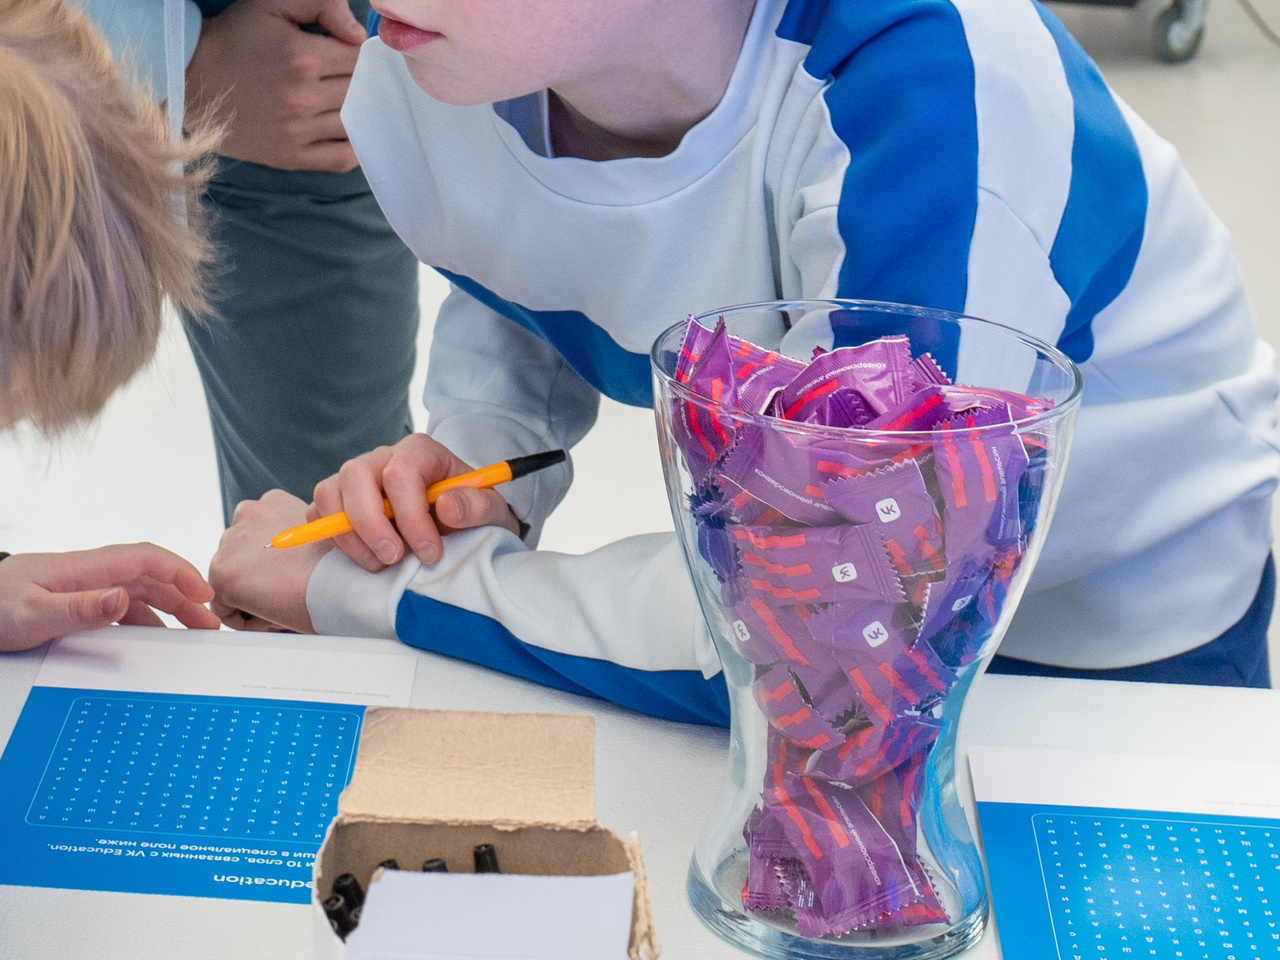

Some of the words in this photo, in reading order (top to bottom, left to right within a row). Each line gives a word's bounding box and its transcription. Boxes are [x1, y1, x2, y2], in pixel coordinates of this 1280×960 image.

[825, 362, 887, 379] конверсионный
[754, 468, 813, 506] конверсионный
[95, 838, 137, 847] ниже.
[140, 842, 177, 850] поле
[47, 843, 122, 856] Education,
[125, 849, 146, 858] VK
[179, 844, 278, 856] специальное
[161, 851, 240, 863] связанных
[244, 856, 283, 866] слов,
[850, 829, 882, 886] конверсионный
[286, 860, 302, 868] 10
[213, 874, 314, 889] education
